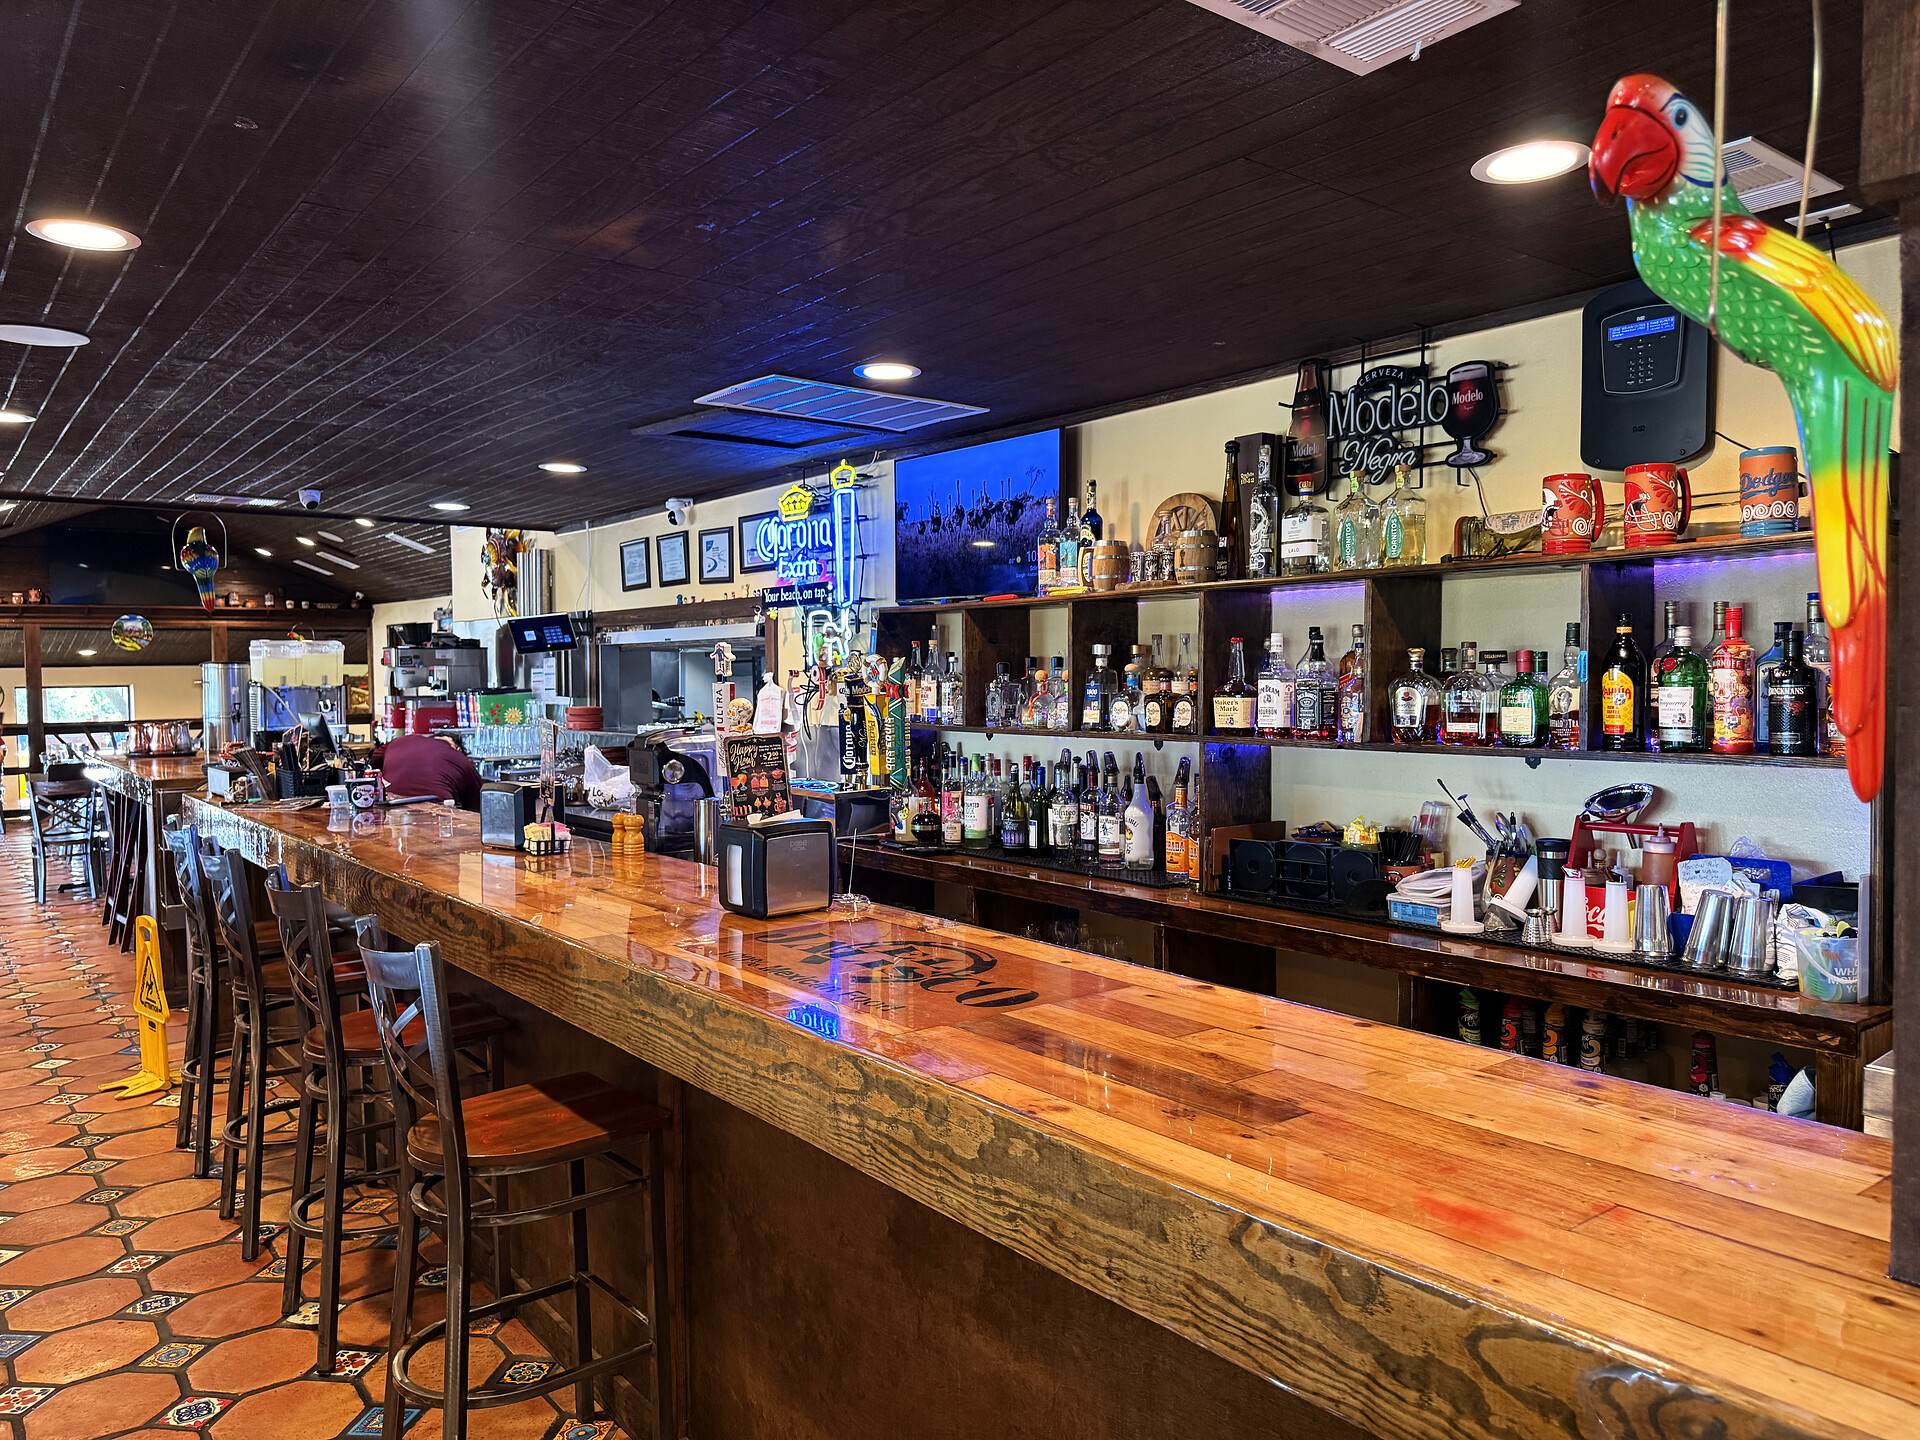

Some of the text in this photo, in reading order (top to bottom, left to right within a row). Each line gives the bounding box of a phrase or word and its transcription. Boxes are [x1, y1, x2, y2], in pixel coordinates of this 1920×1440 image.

[1358, 367, 1405, 387] CERVEZA
[1451, 388, 1484, 405] Modelo
[1326, 377, 1450, 441] Modelo
[1292, 442, 1320, 457] Modelo
[1339, 437, 1417, 485] Negra
[756, 515, 833, 562] Corona
[778, 553, 818, 578] Extra
[763, 587, 828, 603] Your beach, on tap.
[715, 688, 724, 724] ULTRA
[729, 743, 759, 762] Happy
[842, 723, 856, 770] Corona
[733, 753, 756, 773] Hour
[1833, 967, 1859, 977] WHA
